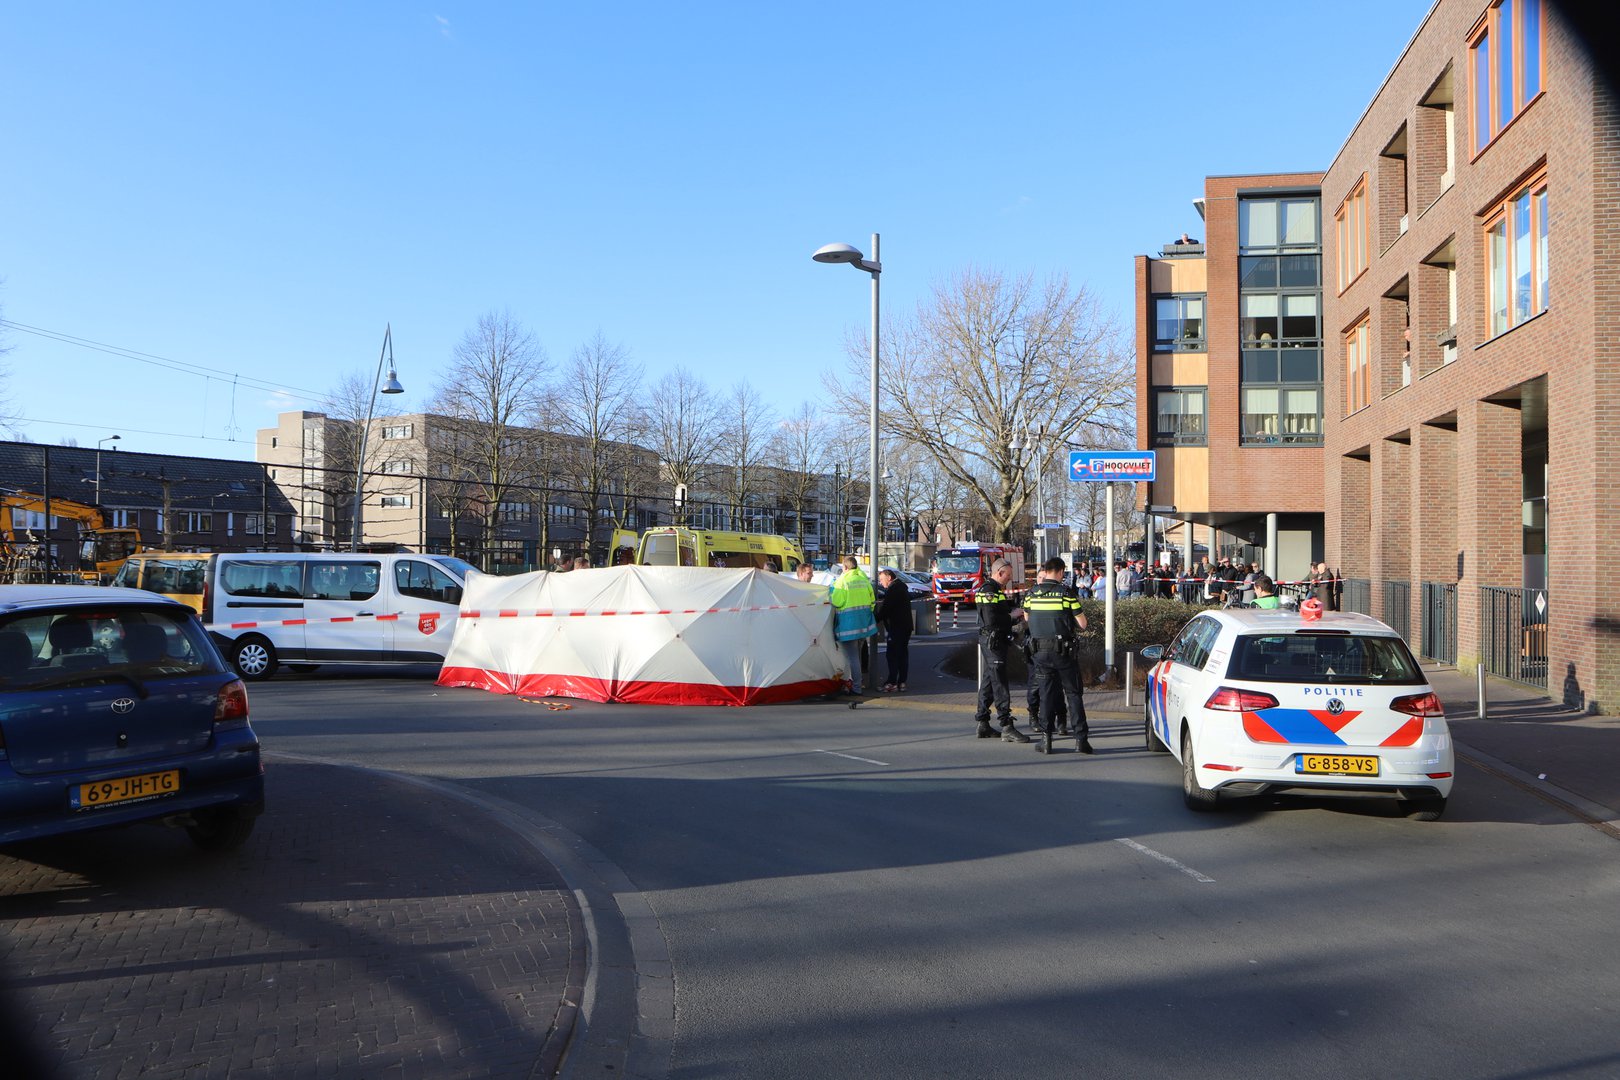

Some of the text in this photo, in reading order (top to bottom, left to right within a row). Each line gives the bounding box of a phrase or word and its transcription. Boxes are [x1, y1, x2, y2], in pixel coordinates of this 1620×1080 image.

[1105, 462, 1151, 470] HOOGVLIET
[1304, 687, 1363, 697] POLITIE
[1307, 757, 1373, 772] G-858-VS
[88, 774, 172, 802] 69-JH-TG
